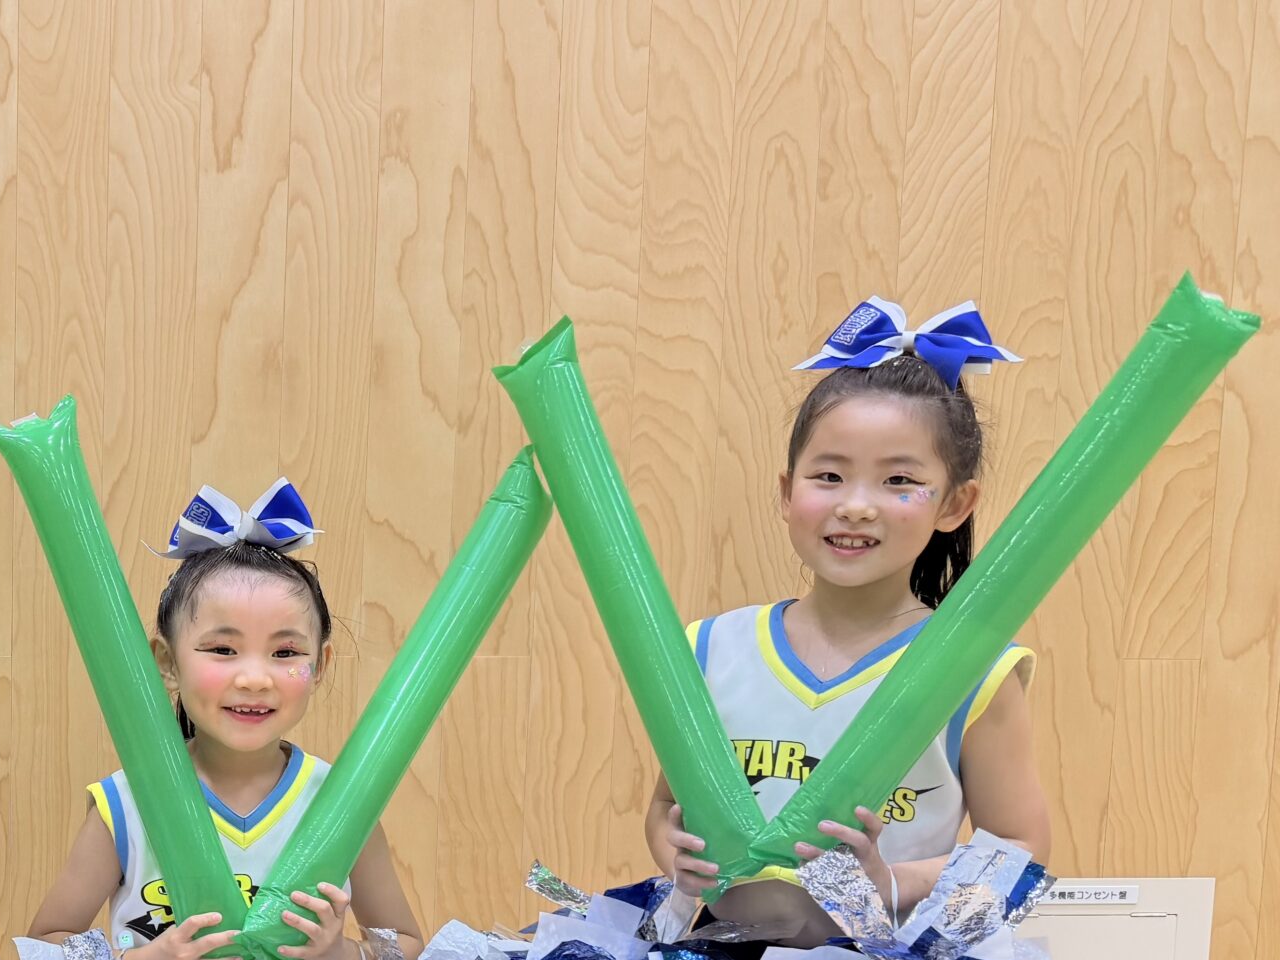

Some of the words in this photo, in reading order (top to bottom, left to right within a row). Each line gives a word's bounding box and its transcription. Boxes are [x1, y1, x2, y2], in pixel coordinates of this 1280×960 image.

[730, 739, 806, 780] TAR
[1049, 891, 1127, 900] 多機能コンセント盤
